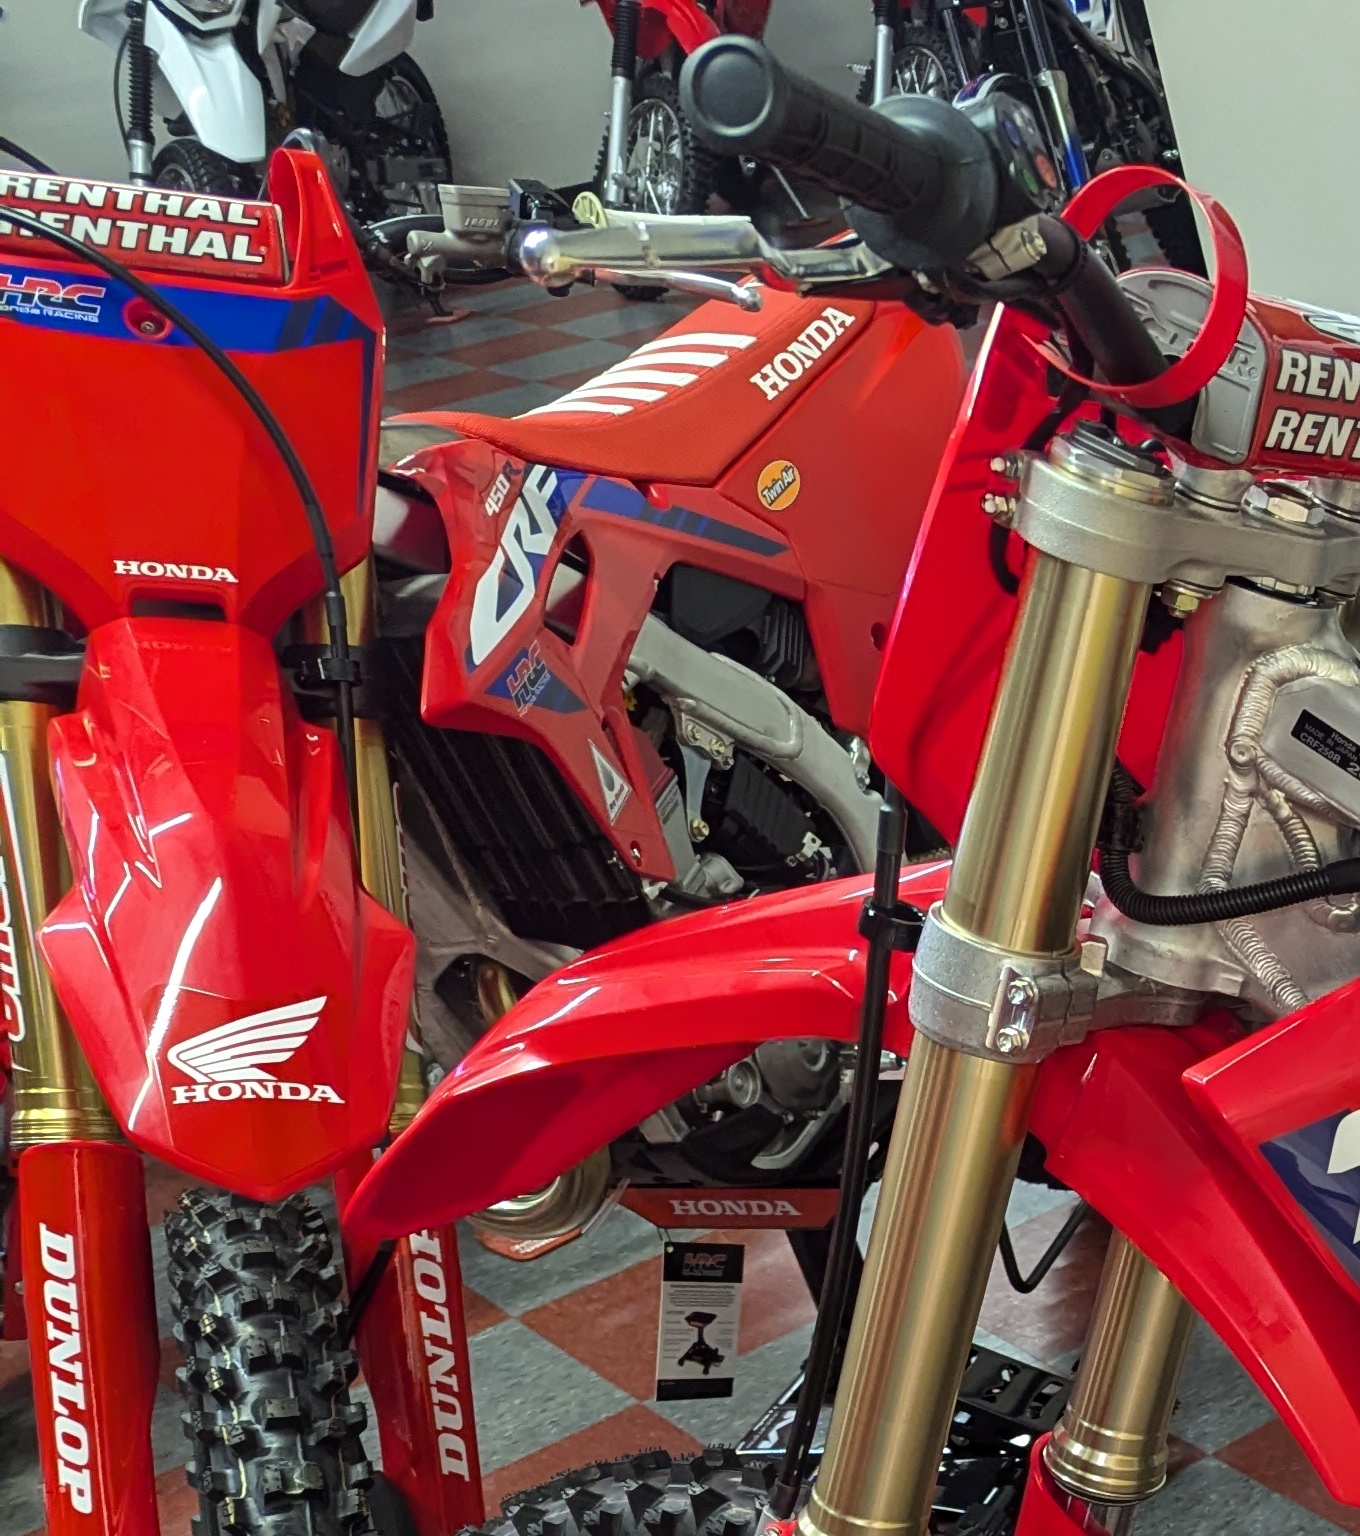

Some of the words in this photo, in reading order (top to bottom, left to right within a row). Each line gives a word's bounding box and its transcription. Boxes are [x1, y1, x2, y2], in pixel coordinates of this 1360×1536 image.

[0, 174, 259, 226] RENTHAL
[749, 306, 856, 401] HONDA
[485, 460, 522, 516] 450R
[113, 559, 239, 583] HONDA
[470, 464, 558, 666] CRF
[1300, 732, 1341, 764] CRF250R
[1304, 722, 1326, 742] MADE
[1335, 745, 1358, 763] JAPAN
[1331, 731, 1357, 753] Honda
[171, 1082, 346, 1105] HONDA
[668, 1199, 802, 1216] HONDA
[39, 1222, 92, 1515] DUNLOP
